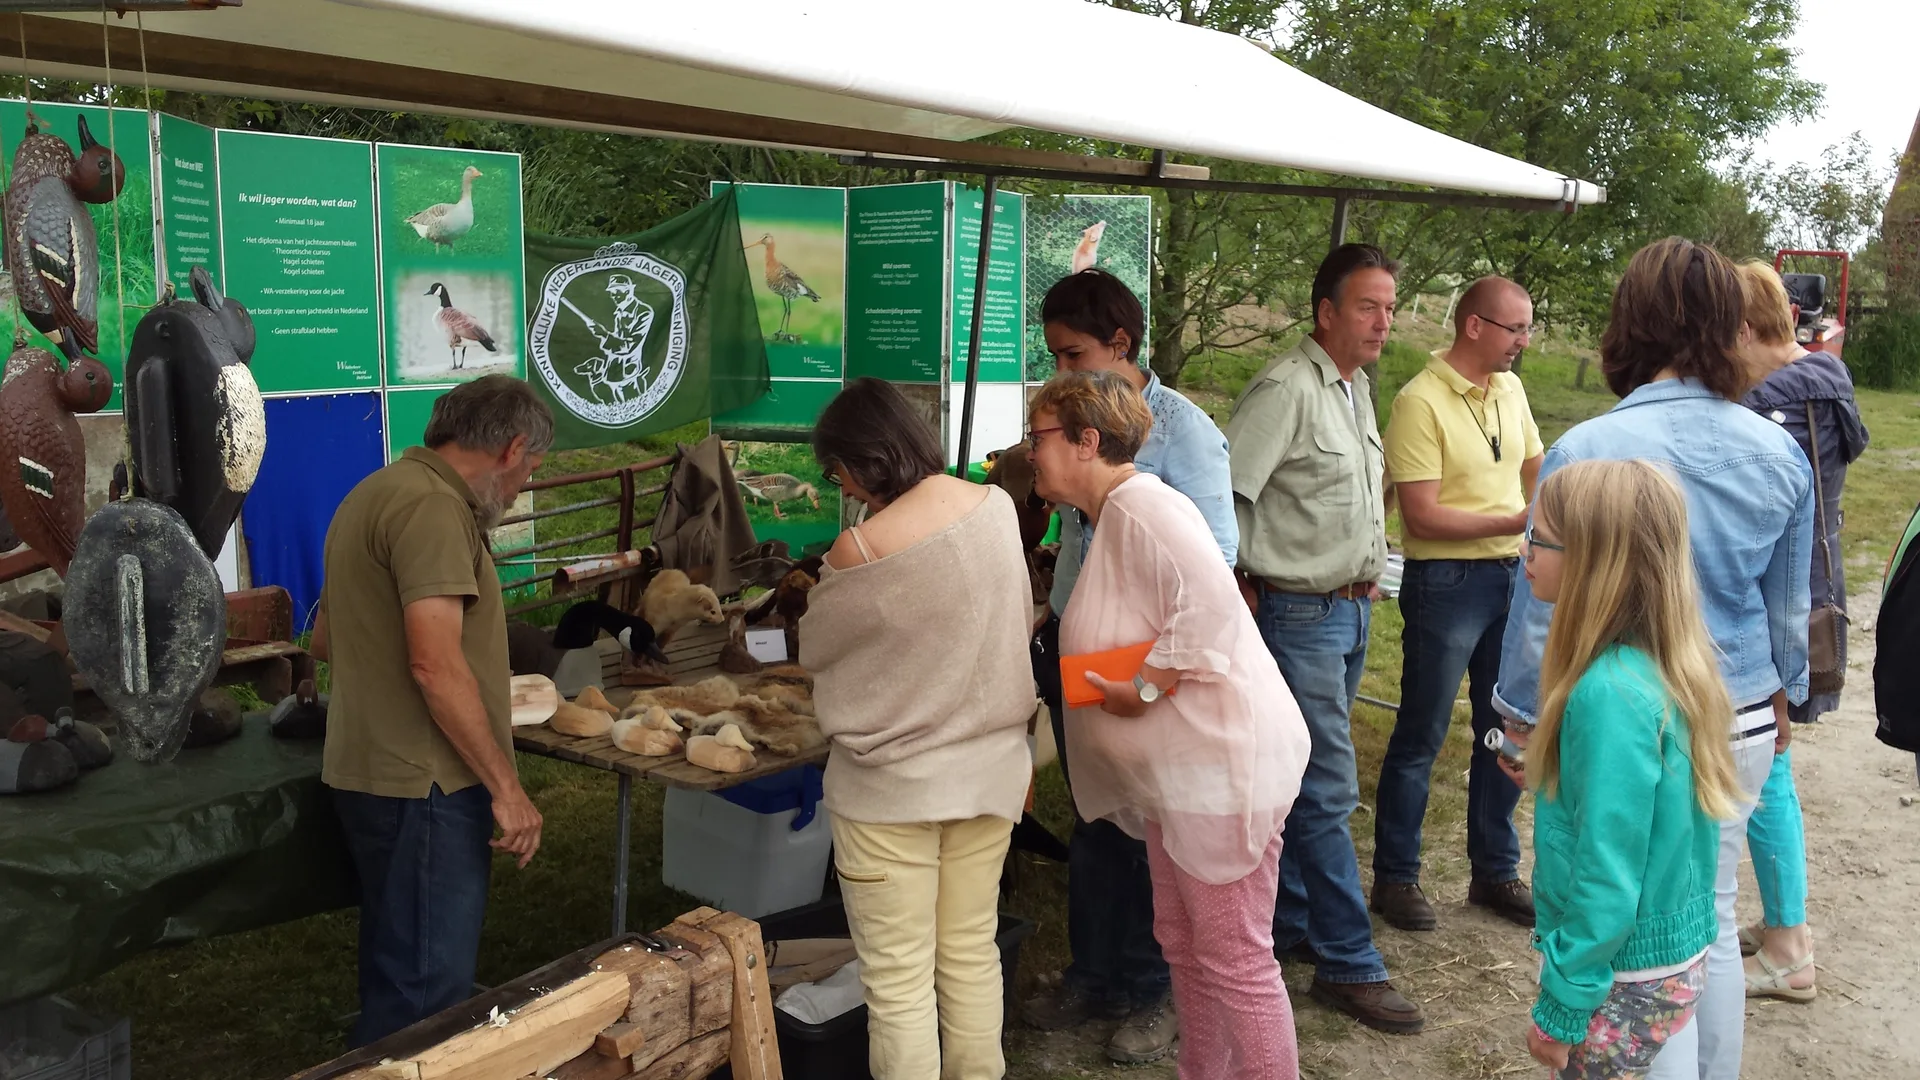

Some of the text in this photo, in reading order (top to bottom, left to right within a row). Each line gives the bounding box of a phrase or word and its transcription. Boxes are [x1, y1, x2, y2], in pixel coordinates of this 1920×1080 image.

[239, 193, 357, 208] Ik wil jager worden, wat dan?
[279, 217, 325, 227] Minimaal 18 jaar
[257, 237, 282, 246] diploma
[294, 238, 305, 246] het
[305, 238, 341, 246] jachtexamen
[275, 247, 312, 255] Theoretische
[283, 258, 300, 266] Hagel
[283, 268, 301, 276] Kogel
[331, 288, 345, 296] jacht
[273, 308, 284, 316] zijn
[307, 307, 334, 316] jachtveld
[340, 307, 369, 315] Nederland
[533, 298, 562, 391] KONINKLIJKE
[548, 257, 635, 296] NEDERLANDSE
[274, 327, 290, 335] Geen
[291, 327, 316, 335] strafblad
